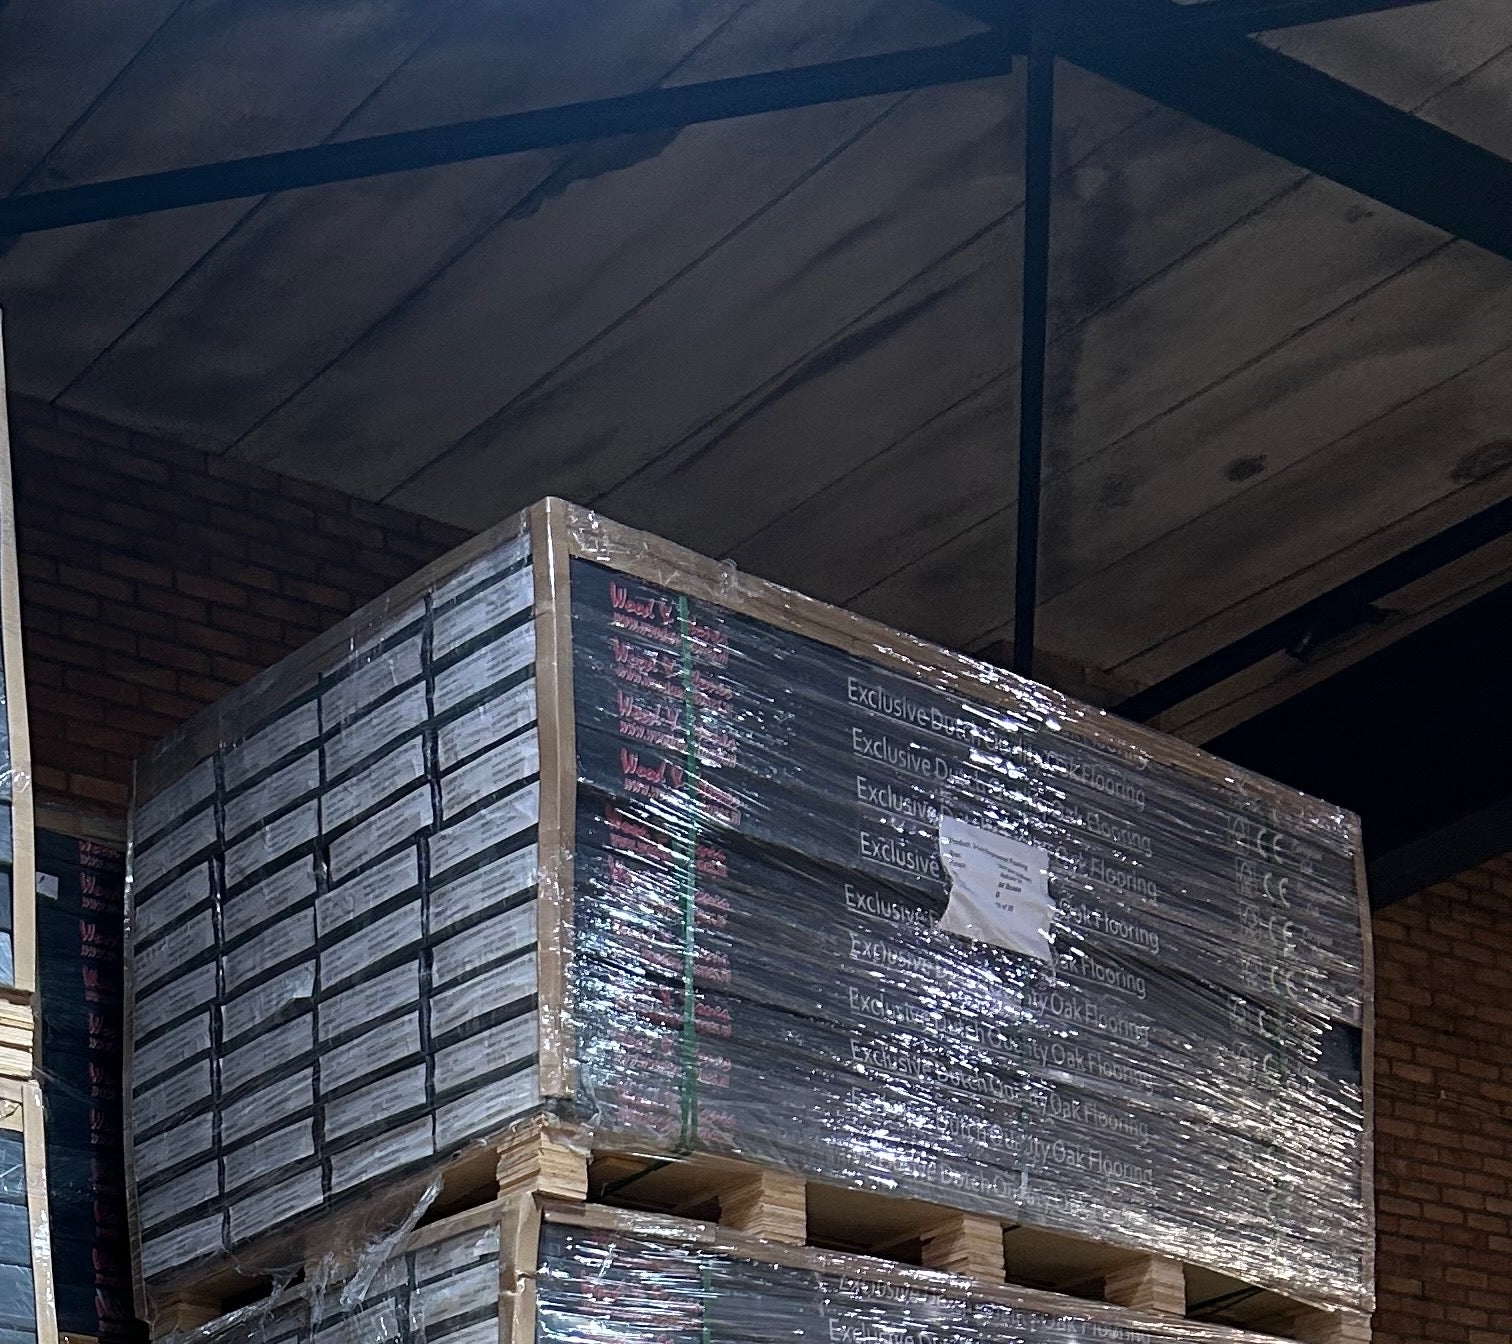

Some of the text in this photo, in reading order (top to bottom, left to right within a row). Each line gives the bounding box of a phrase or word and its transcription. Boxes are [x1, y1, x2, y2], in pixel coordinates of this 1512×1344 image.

[848, 676, 926, 726] Exclusive
[852, 727, 931, 775] Exclusive
[860, 832, 938, 877] Exclusive
